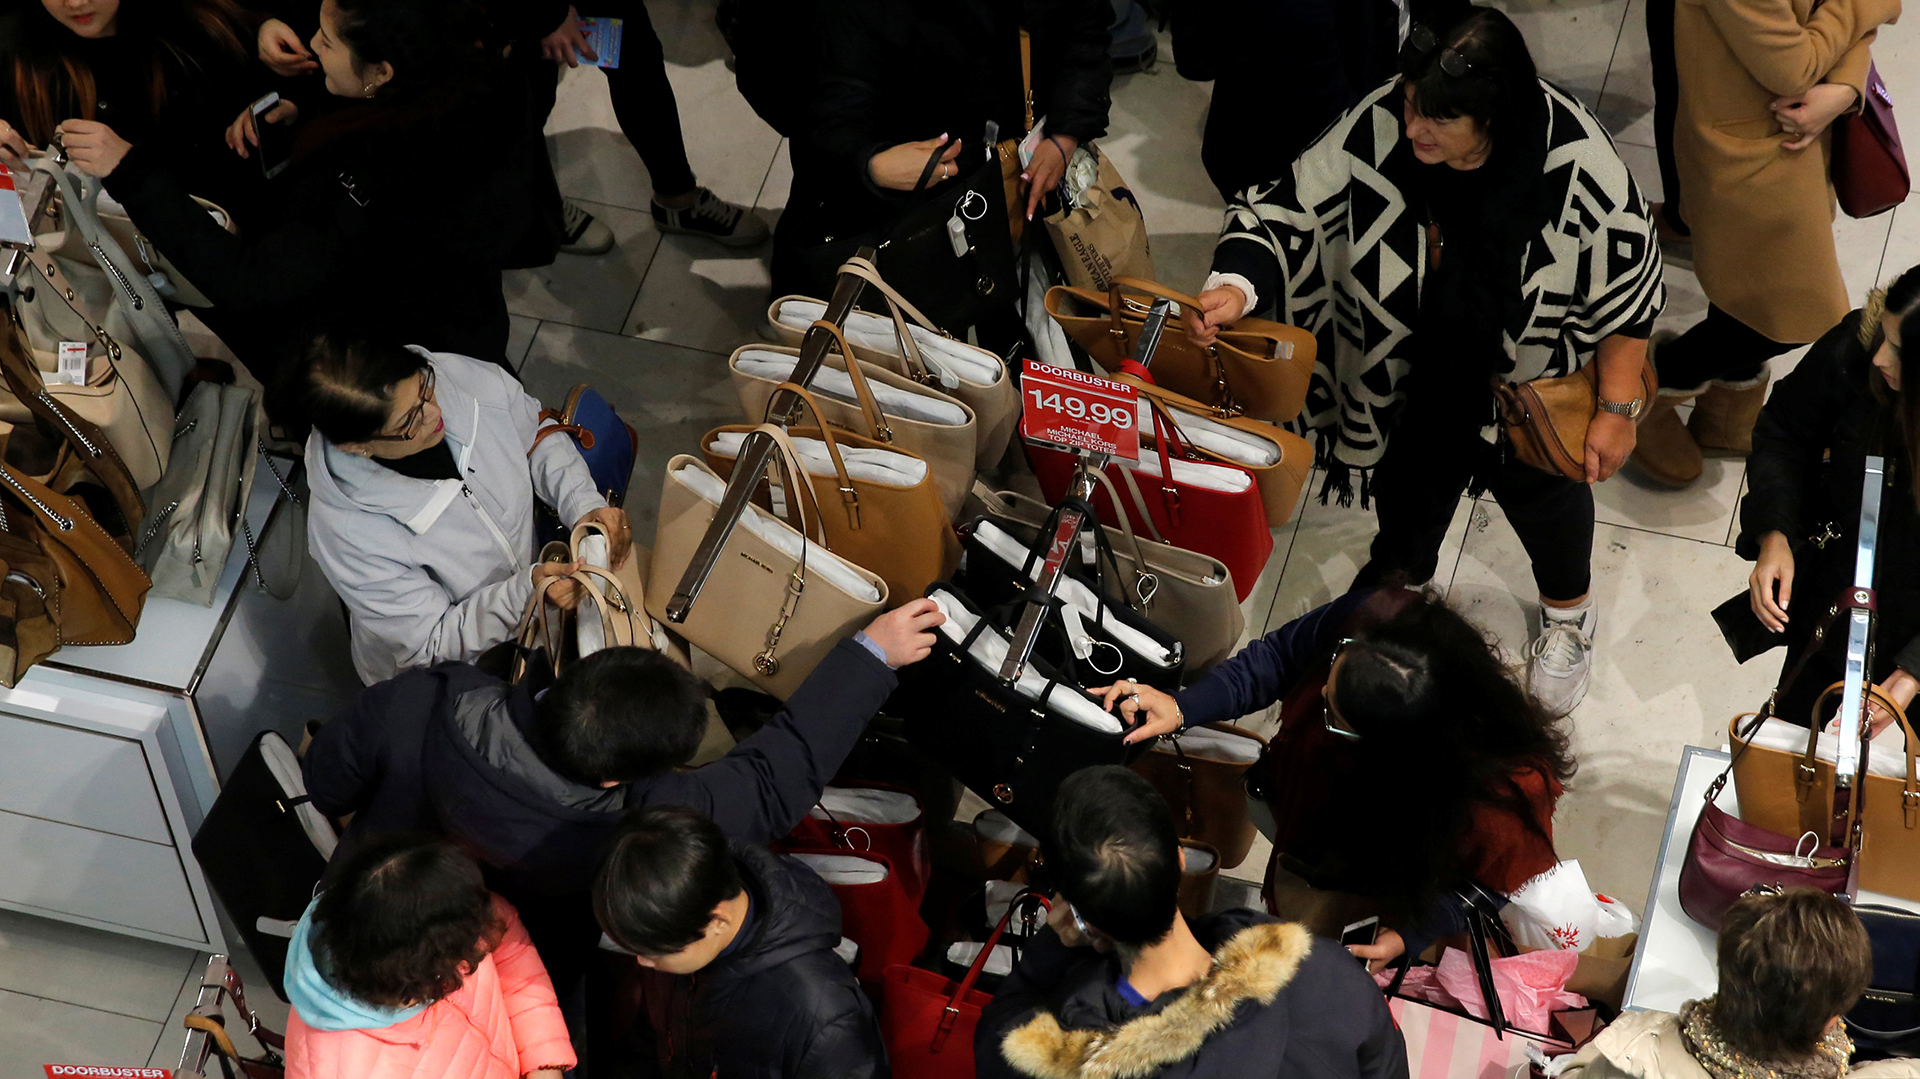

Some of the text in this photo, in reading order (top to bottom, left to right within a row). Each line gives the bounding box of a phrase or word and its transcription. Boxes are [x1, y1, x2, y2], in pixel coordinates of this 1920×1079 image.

[1069, 232, 1091, 263] EAGLE
[1087, 243, 1113, 283] UTFITTERS
[1085, 262, 1109, 293] ERICAN
[1030, 361, 1131, 393] DOORBUSTER
[1028, 388, 1132, 429] 149.99
[1046, 428, 1117, 449] MICHAEL KORS
[1048, 433, 1068, 443] TOP
[1086, 442, 1116, 455] TOTES
[1060, 425, 1103, 441] MICHAEL
[52, 1065, 164, 1078] DOORBUSTER
